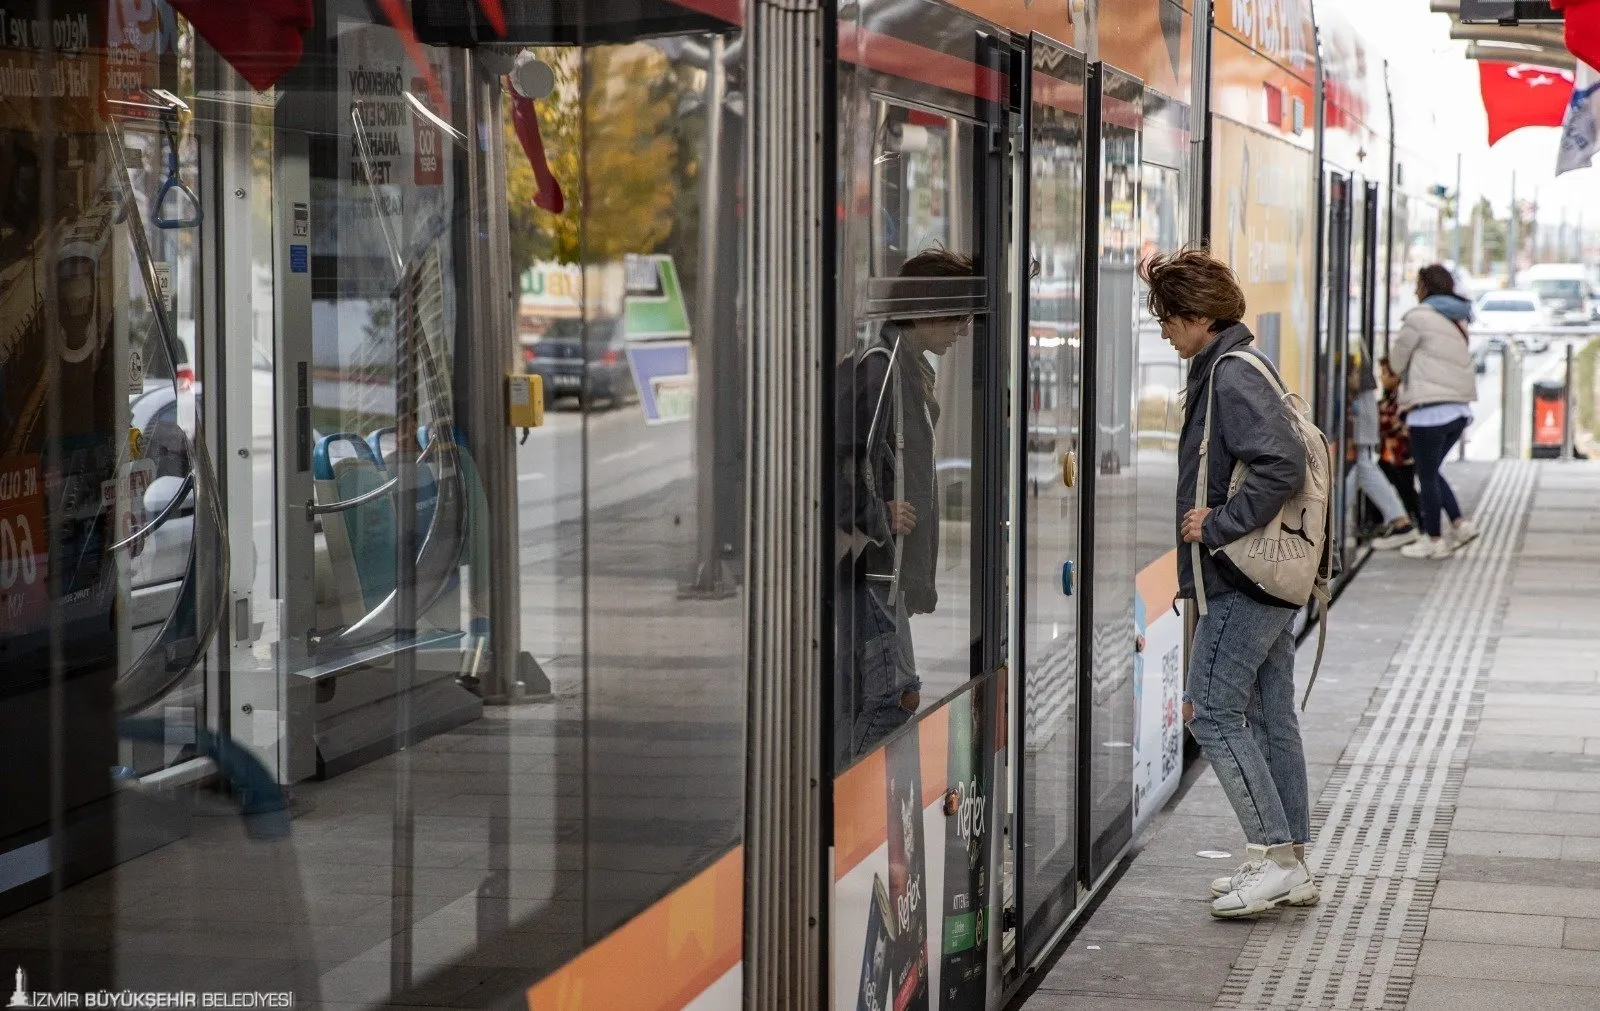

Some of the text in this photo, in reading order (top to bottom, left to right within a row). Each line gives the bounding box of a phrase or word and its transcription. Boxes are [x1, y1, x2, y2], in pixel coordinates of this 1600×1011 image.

[1248, 537, 1305, 562] PUMA
[957, 774, 986, 851] Reflex
[897, 873, 921, 936] Reflex
